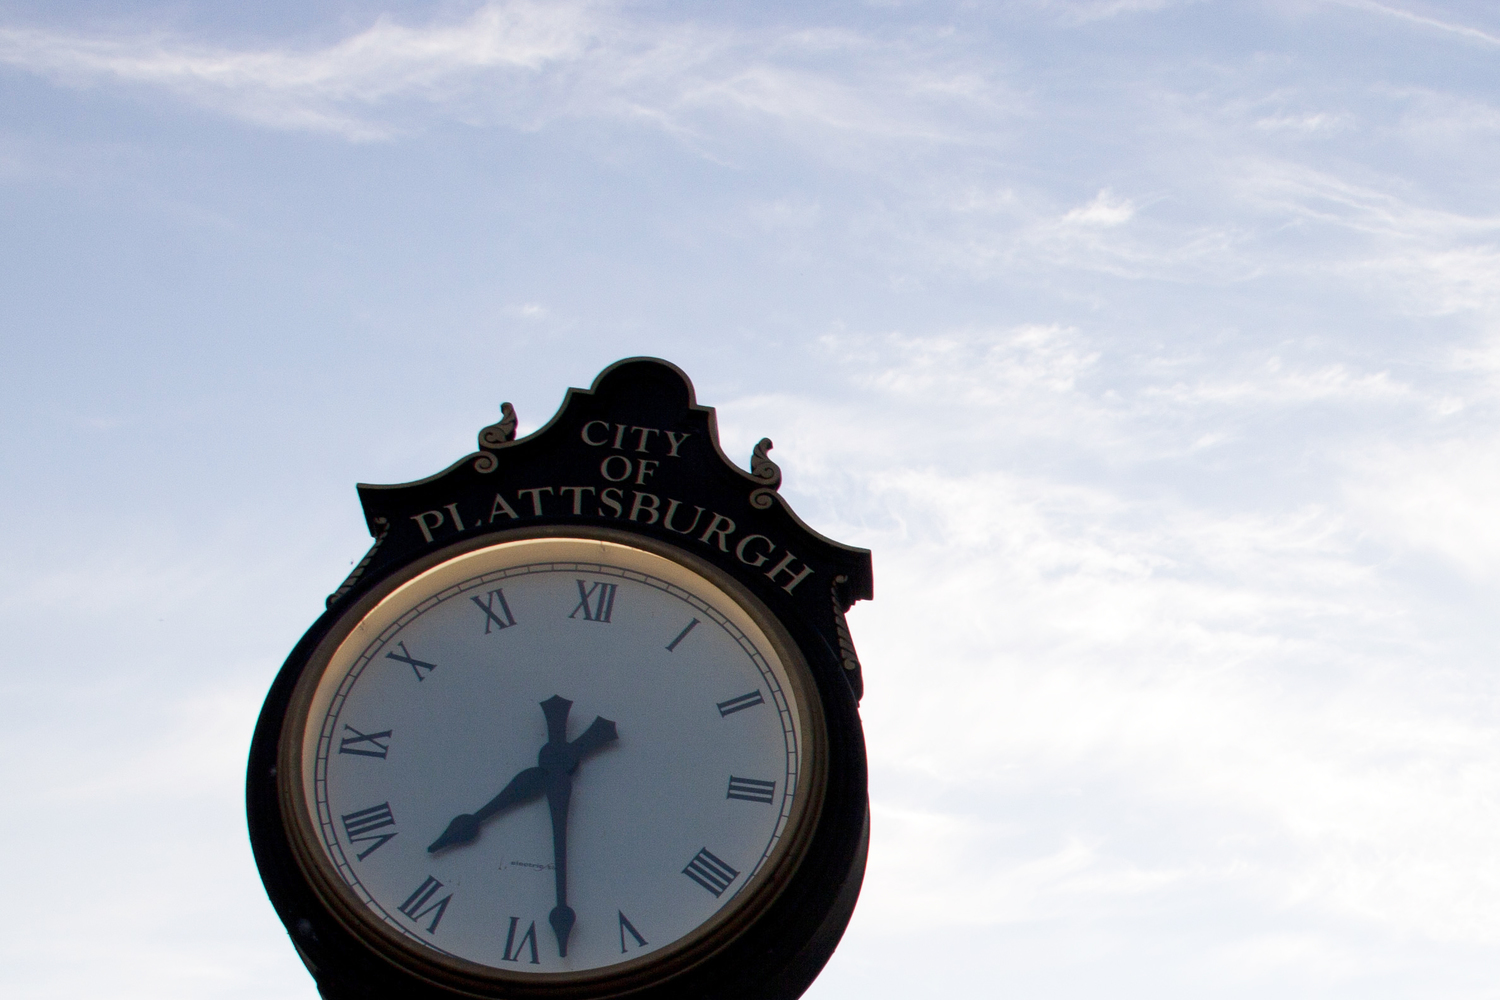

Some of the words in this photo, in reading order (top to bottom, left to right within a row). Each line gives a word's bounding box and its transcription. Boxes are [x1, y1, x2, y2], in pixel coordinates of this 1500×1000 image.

[580, 419, 692, 458] CITY
[599, 454, 661, 486] OF
[410, 485, 816, 598] PLATTSBURGH
[469, 587, 518, 635] XI
[568, 579, 619, 624] XII
[385, 640, 438, 682] X
[716, 689, 766, 718] II
[338, 723, 393, 760] IX
[726, 775, 777, 805] III
[341, 801, 399, 862] VIII
[681, 847, 741, 898] IIII
[396, 875, 454, 935] VII
[500, 916, 541, 965] VI
[617, 909, 649, 954] V
